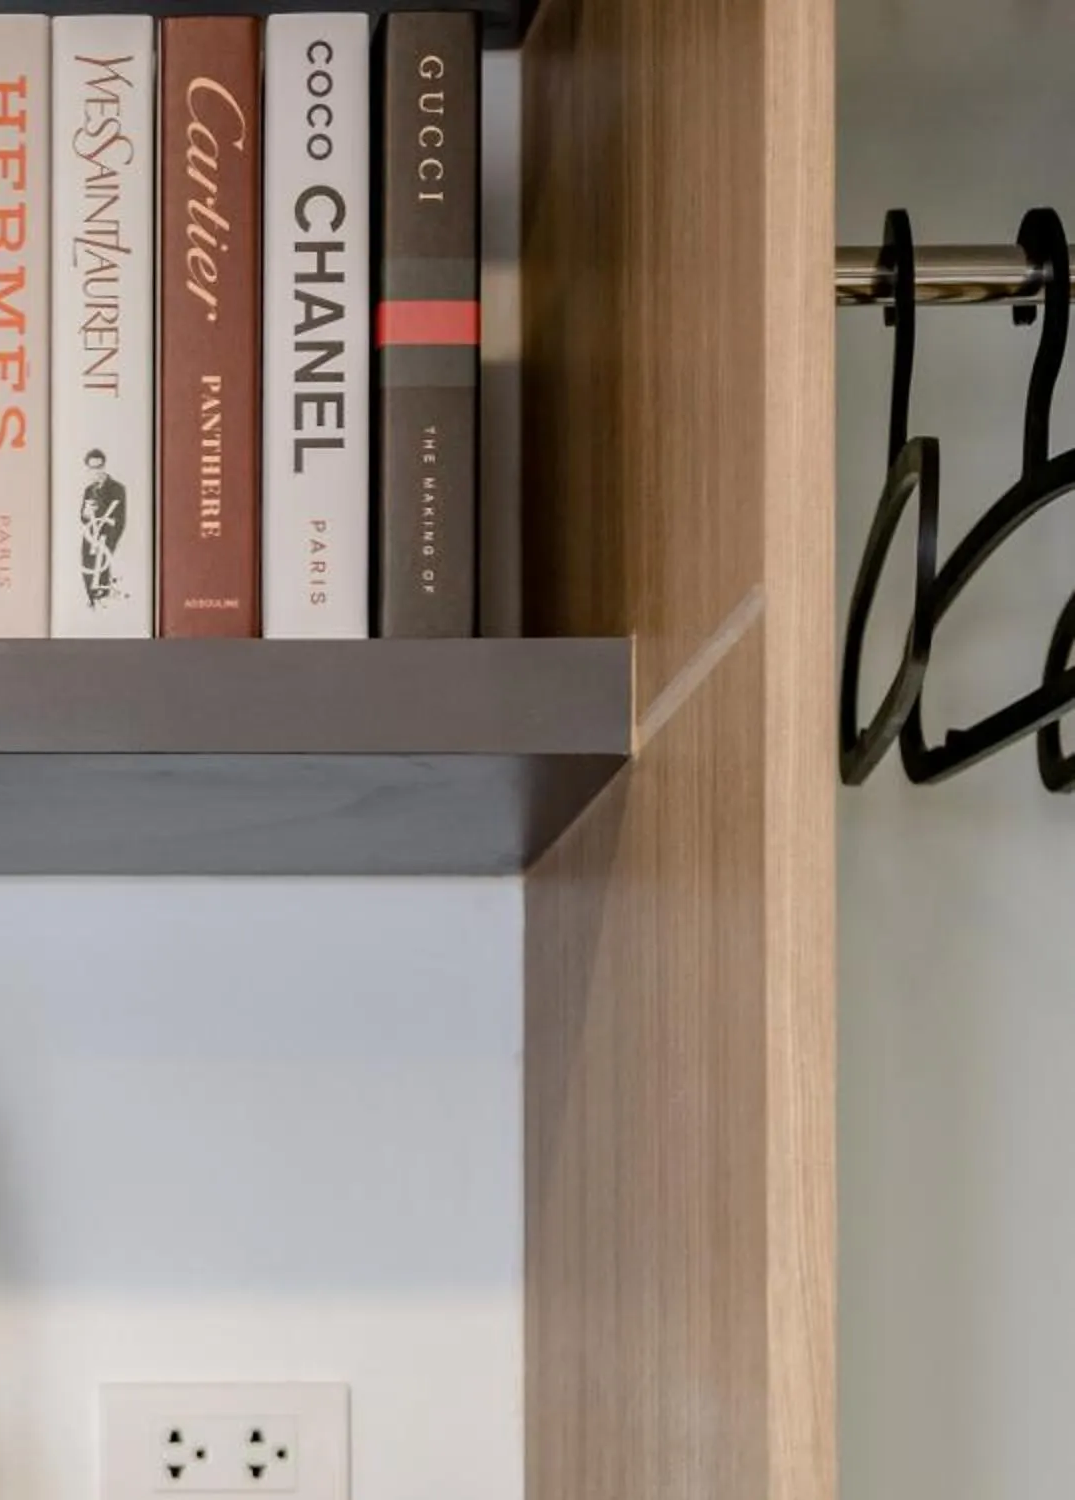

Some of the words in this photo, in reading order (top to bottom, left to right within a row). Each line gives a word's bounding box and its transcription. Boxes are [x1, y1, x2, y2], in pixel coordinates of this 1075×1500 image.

[306, 39, 334, 161] COCO
[418, 55, 444, 201] GUCCI
[185, 76, 246, 322] Cartier
[293, 184, 347, 475] CHANEL
[423, 426, 436, 463] THE
[310, 520, 327, 606] PARIS
[423, 477, 435, 556] MAKING
[423, 569, 435, 593] OF
